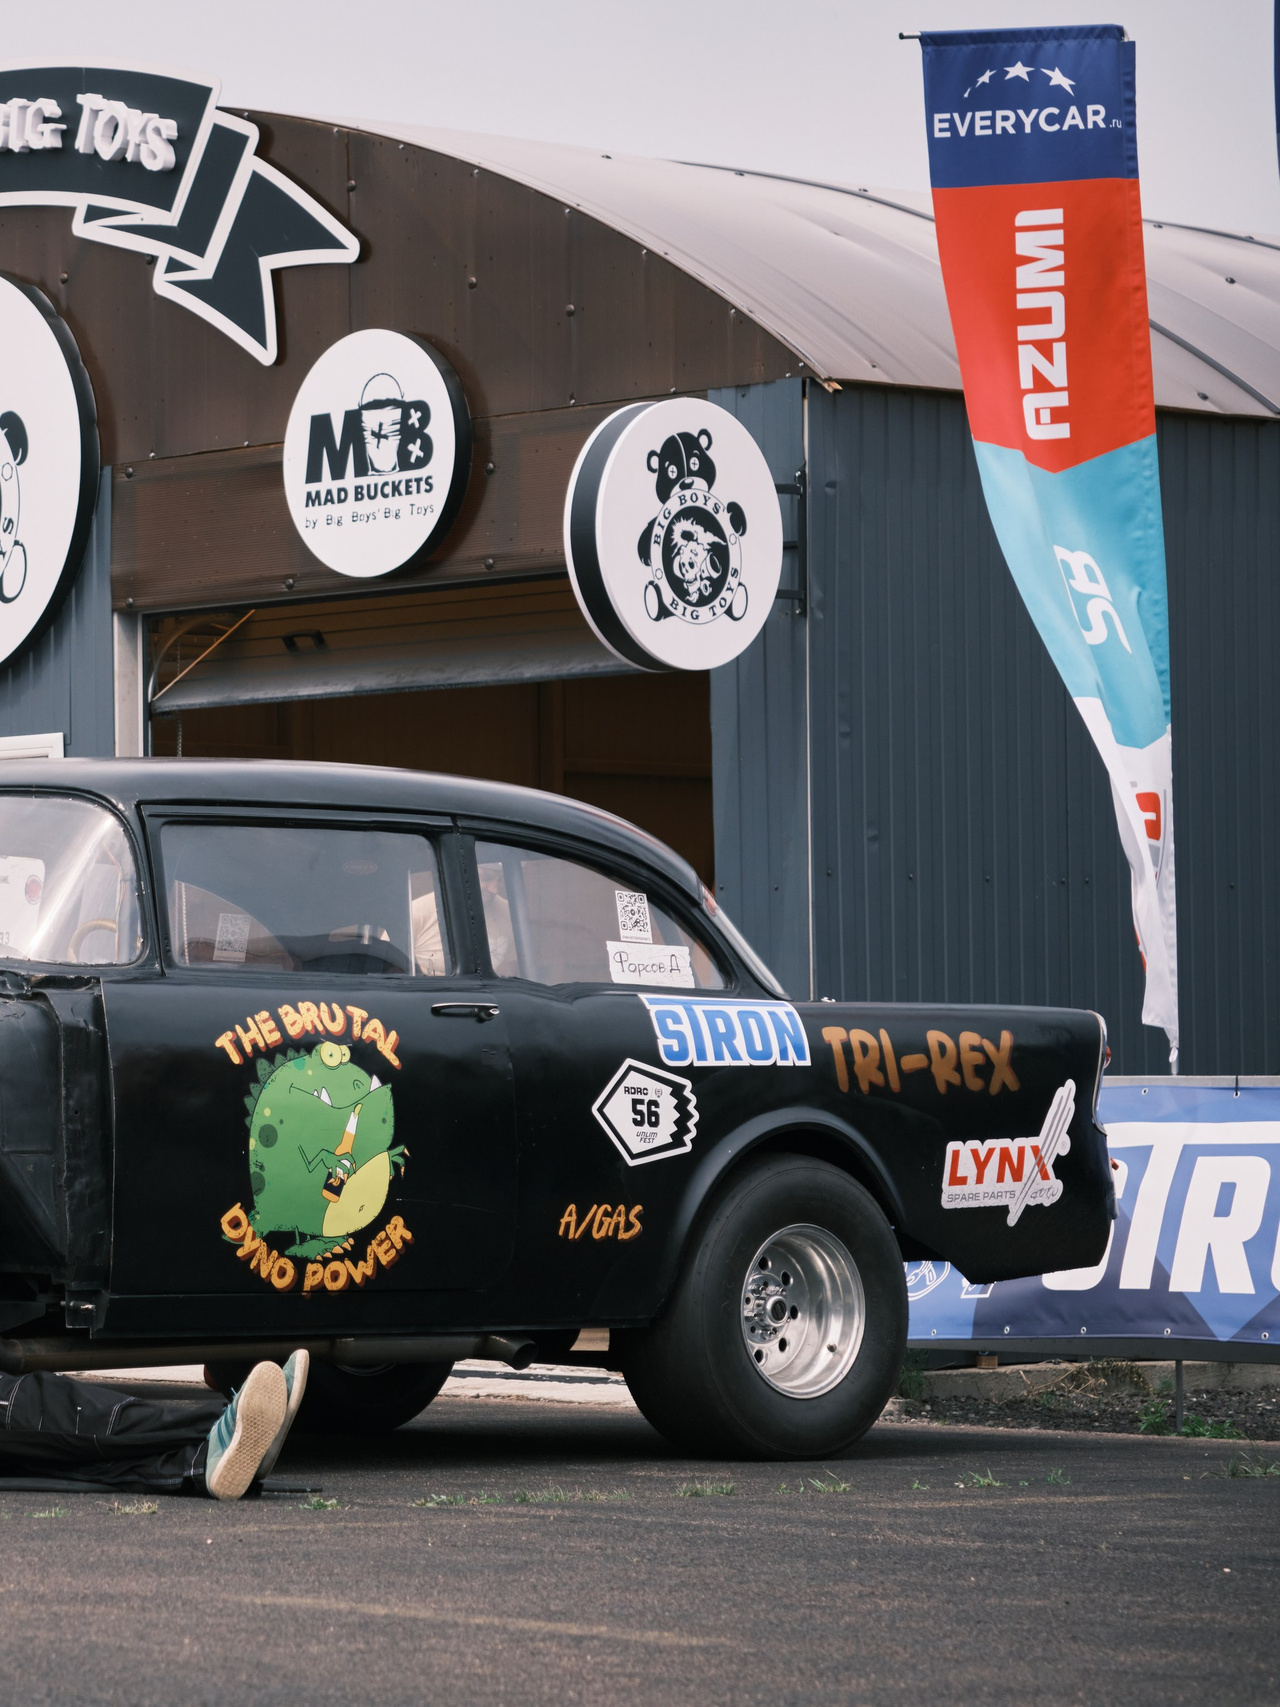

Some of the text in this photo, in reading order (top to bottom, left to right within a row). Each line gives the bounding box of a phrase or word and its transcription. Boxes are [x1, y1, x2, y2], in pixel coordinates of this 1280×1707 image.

[75, 93, 179, 171] TOYS
[1015, 207, 1071, 440] AZUMI
[305, 475, 434, 508] MAD BUCKETS
[305, 516, 318, 529] by
[326, 513, 343, 527] Big
[384, 507, 401, 520] Big
[410, 503, 434, 515] Toys
[653, 508, 672, 547] BIG
[669, 566, 739, 621] BIG TOYS
[613, 951, 666, 978] Форсов
[215, 1001, 402, 1069] THE BRUTAL
[821, 1025, 1020, 1096] TRI-REX
[624, 1086, 648, 1096] RDRC
[631, 1098, 660, 1128] 56
[948, 1144, 1052, 1187] LYNX
[947, 1192, 981, 1203] SPARE
[982, 1190, 1016, 1200] PARTS
[558, 1203, 644, 1241] A/GAS
[220, 1202, 415, 1297] DYNO POWER
